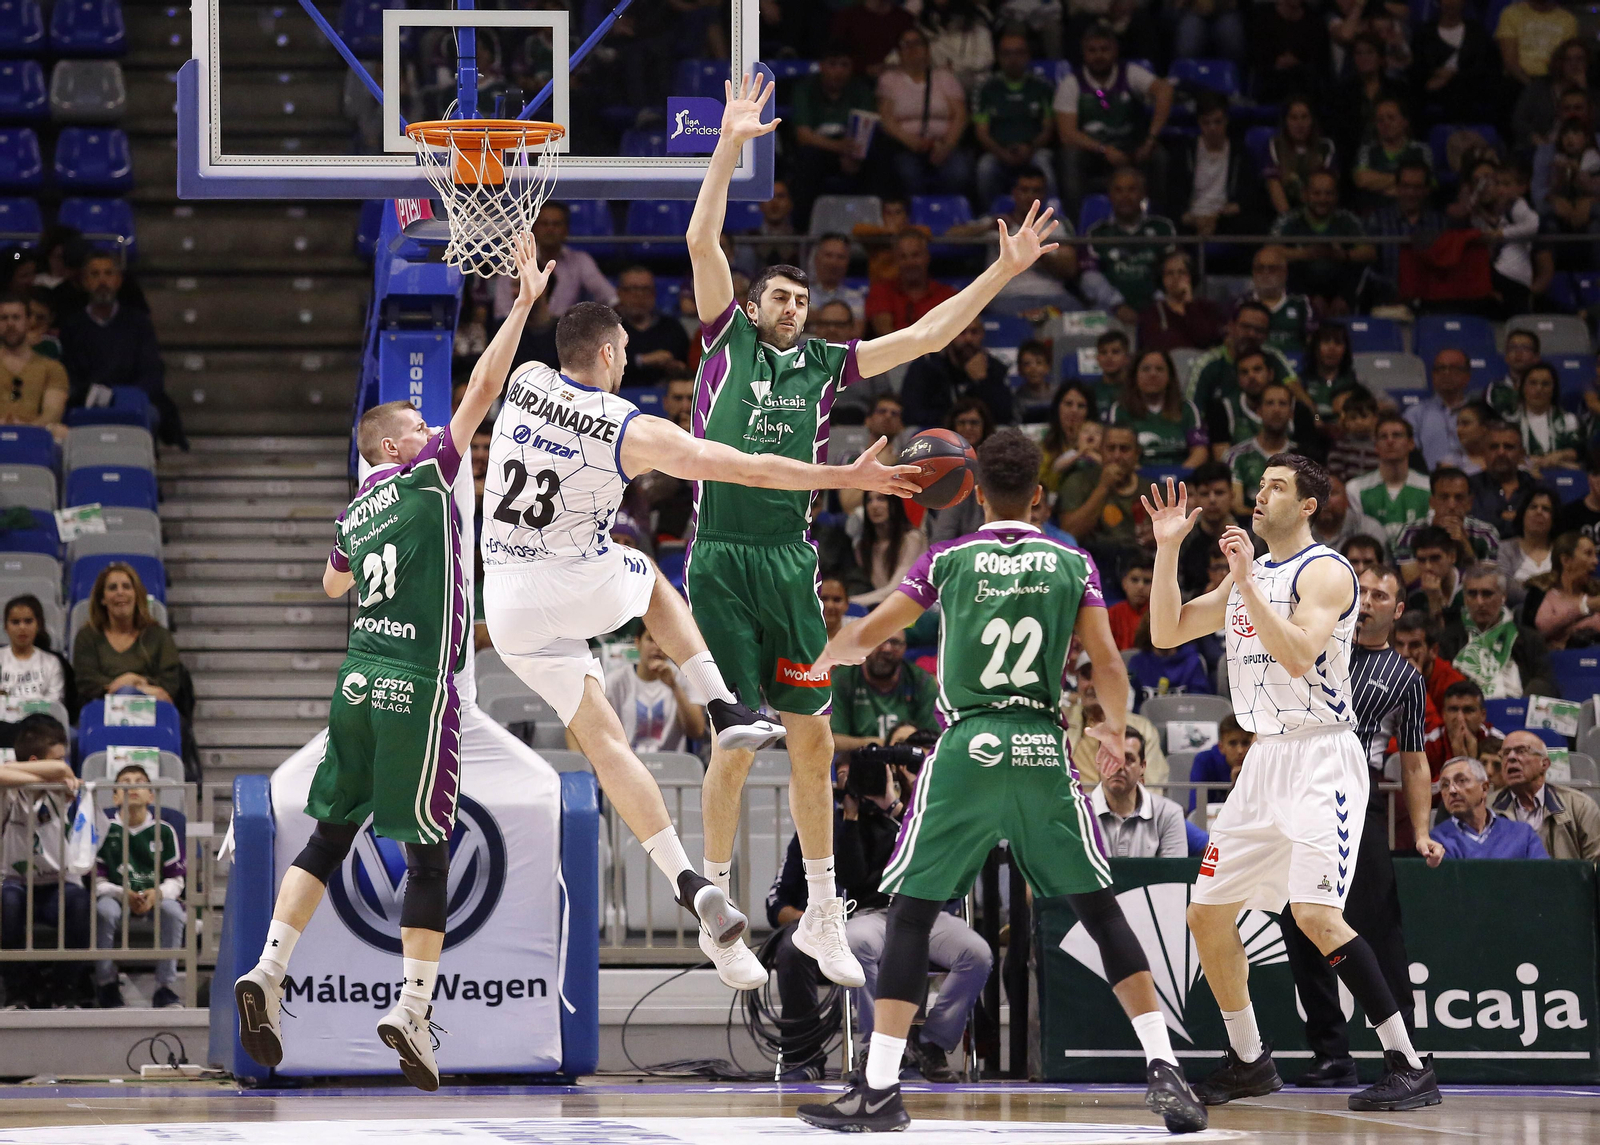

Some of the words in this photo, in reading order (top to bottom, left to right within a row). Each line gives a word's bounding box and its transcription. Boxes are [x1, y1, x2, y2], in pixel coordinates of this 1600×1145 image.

[685, 114, 700, 128] liga
[410, 352, 423, 417] MOND
[508, 382, 619, 444] BURJANADZE
[493, 459, 561, 528] 23
[357, 543, 398, 608] 21
[974, 551, 1058, 576] ROBERTS
[353, 616, 416, 640] worten
[979, 616, 1043, 690] 22
[374, 676, 415, 693] COSTA
[783, 666, 829, 682] worn
[371, 689, 388, 700] DEL
[389, 691, 413, 704] SOL
[371, 699, 411, 714] MÁLAGA
[1011, 733, 1058, 745] COSTA
[1011, 746, 1036, 756] DEL
[1037, 746, 1060, 756] SOL
[1011, 756, 1060, 767] MÁLAGA
[431, 973, 548, 1007] Wagen
[1295, 962, 1588, 1047] icaja
